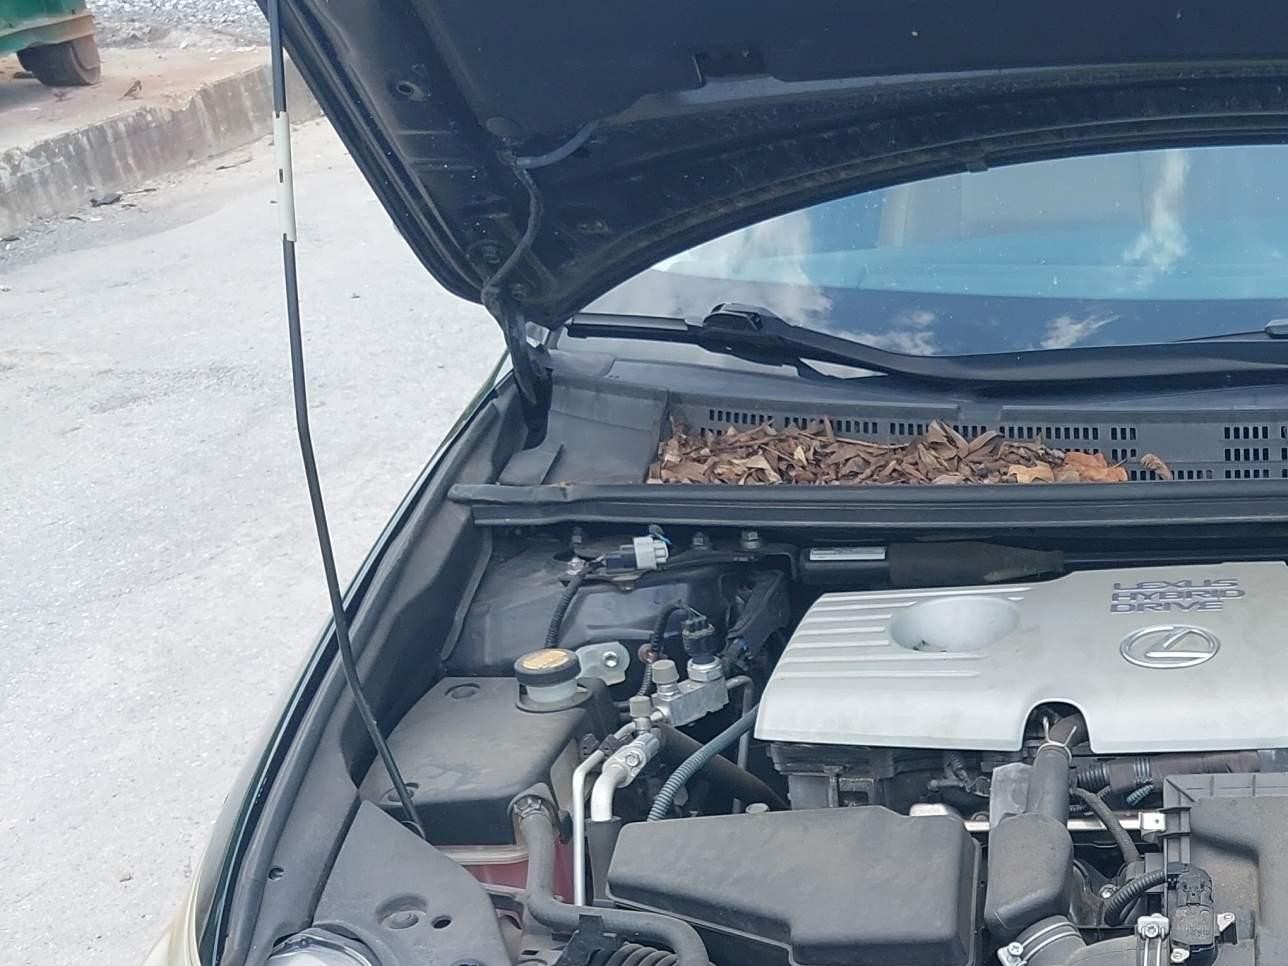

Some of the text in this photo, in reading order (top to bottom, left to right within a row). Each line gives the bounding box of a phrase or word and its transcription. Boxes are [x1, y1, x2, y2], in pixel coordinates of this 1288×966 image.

[1113, 579, 1240, 591] LEXUS
[1111, 589, 1246, 601] HYBRID
[1110, 600, 1225, 613] DRIVE
